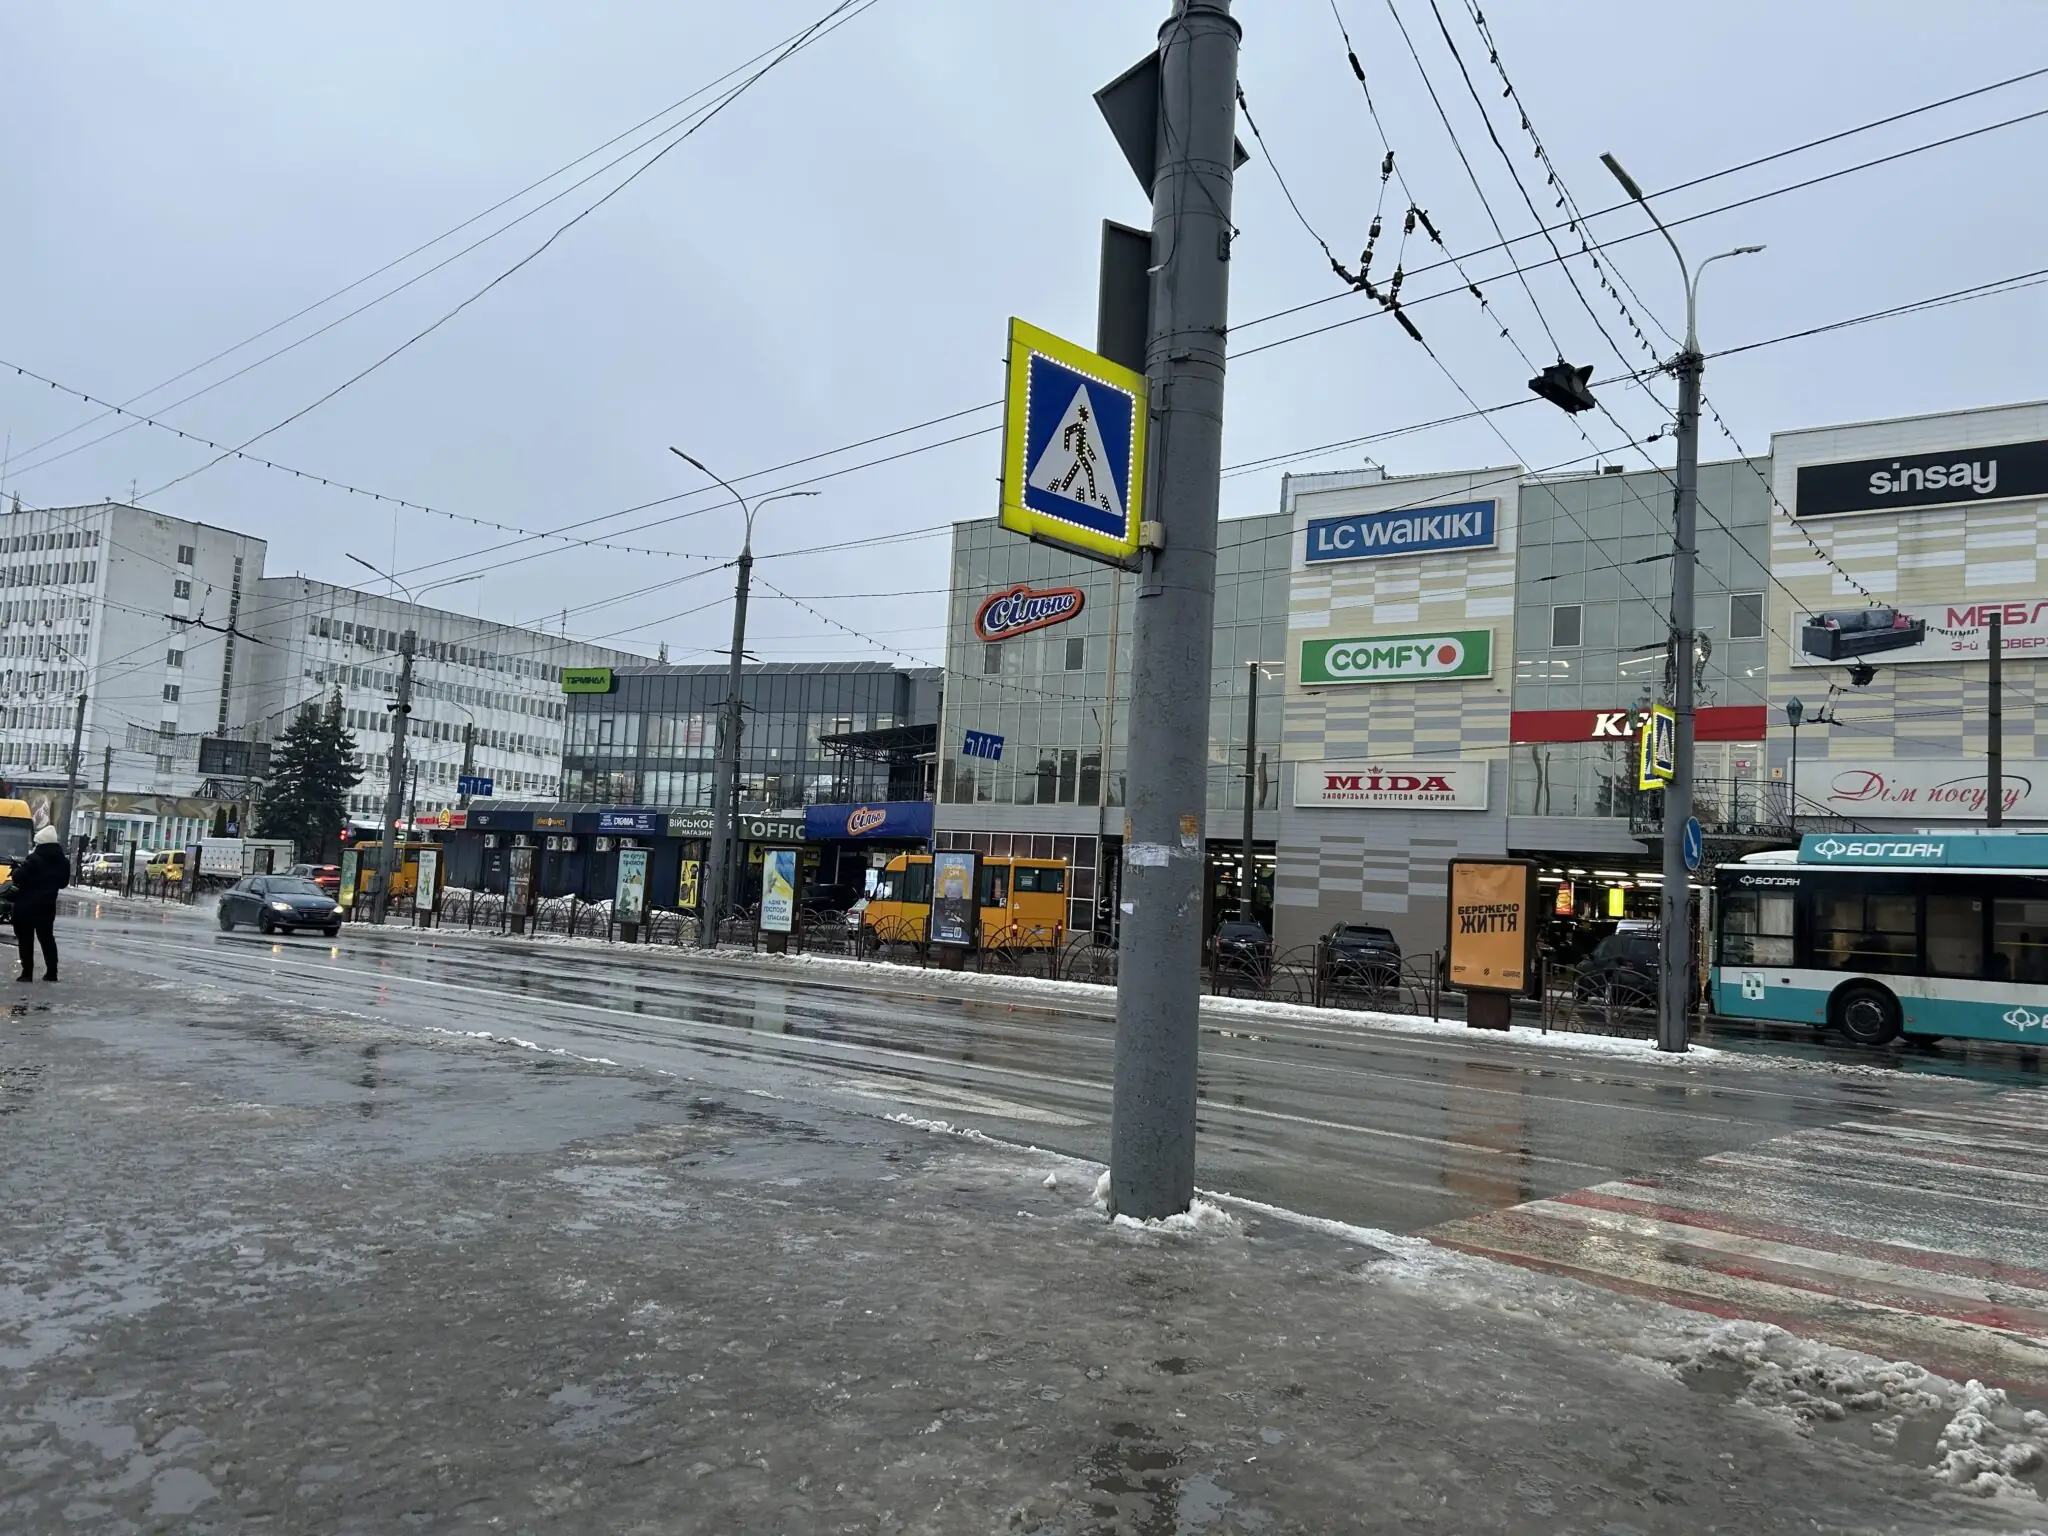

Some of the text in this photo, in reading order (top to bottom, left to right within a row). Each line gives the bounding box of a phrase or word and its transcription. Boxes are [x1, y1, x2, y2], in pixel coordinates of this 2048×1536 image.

[1868, 460, 1998, 495] sinsay
[1318, 525, 1356, 551] LC
[984, 592, 1076, 632] Сільпо
[1331, 643, 1436, 671] COMFY
[1323, 775, 1455, 792] MIDA
[1827, 770, 2026, 812] Дім посуу
[1322, 792, 1456, 802] ЗАПОРІЗЬКА ВЗУТТЄВА ФАБРИКА
[848, 809, 886, 833] Сільпо
[1846, 841, 1945, 858] БОГДАН
[1754, 876, 1801, 887] БОГДАН
[1457, 903, 1520, 915] БЕРЕЖЕМО
[1459, 913, 1519, 935] ЖИТТЯ
